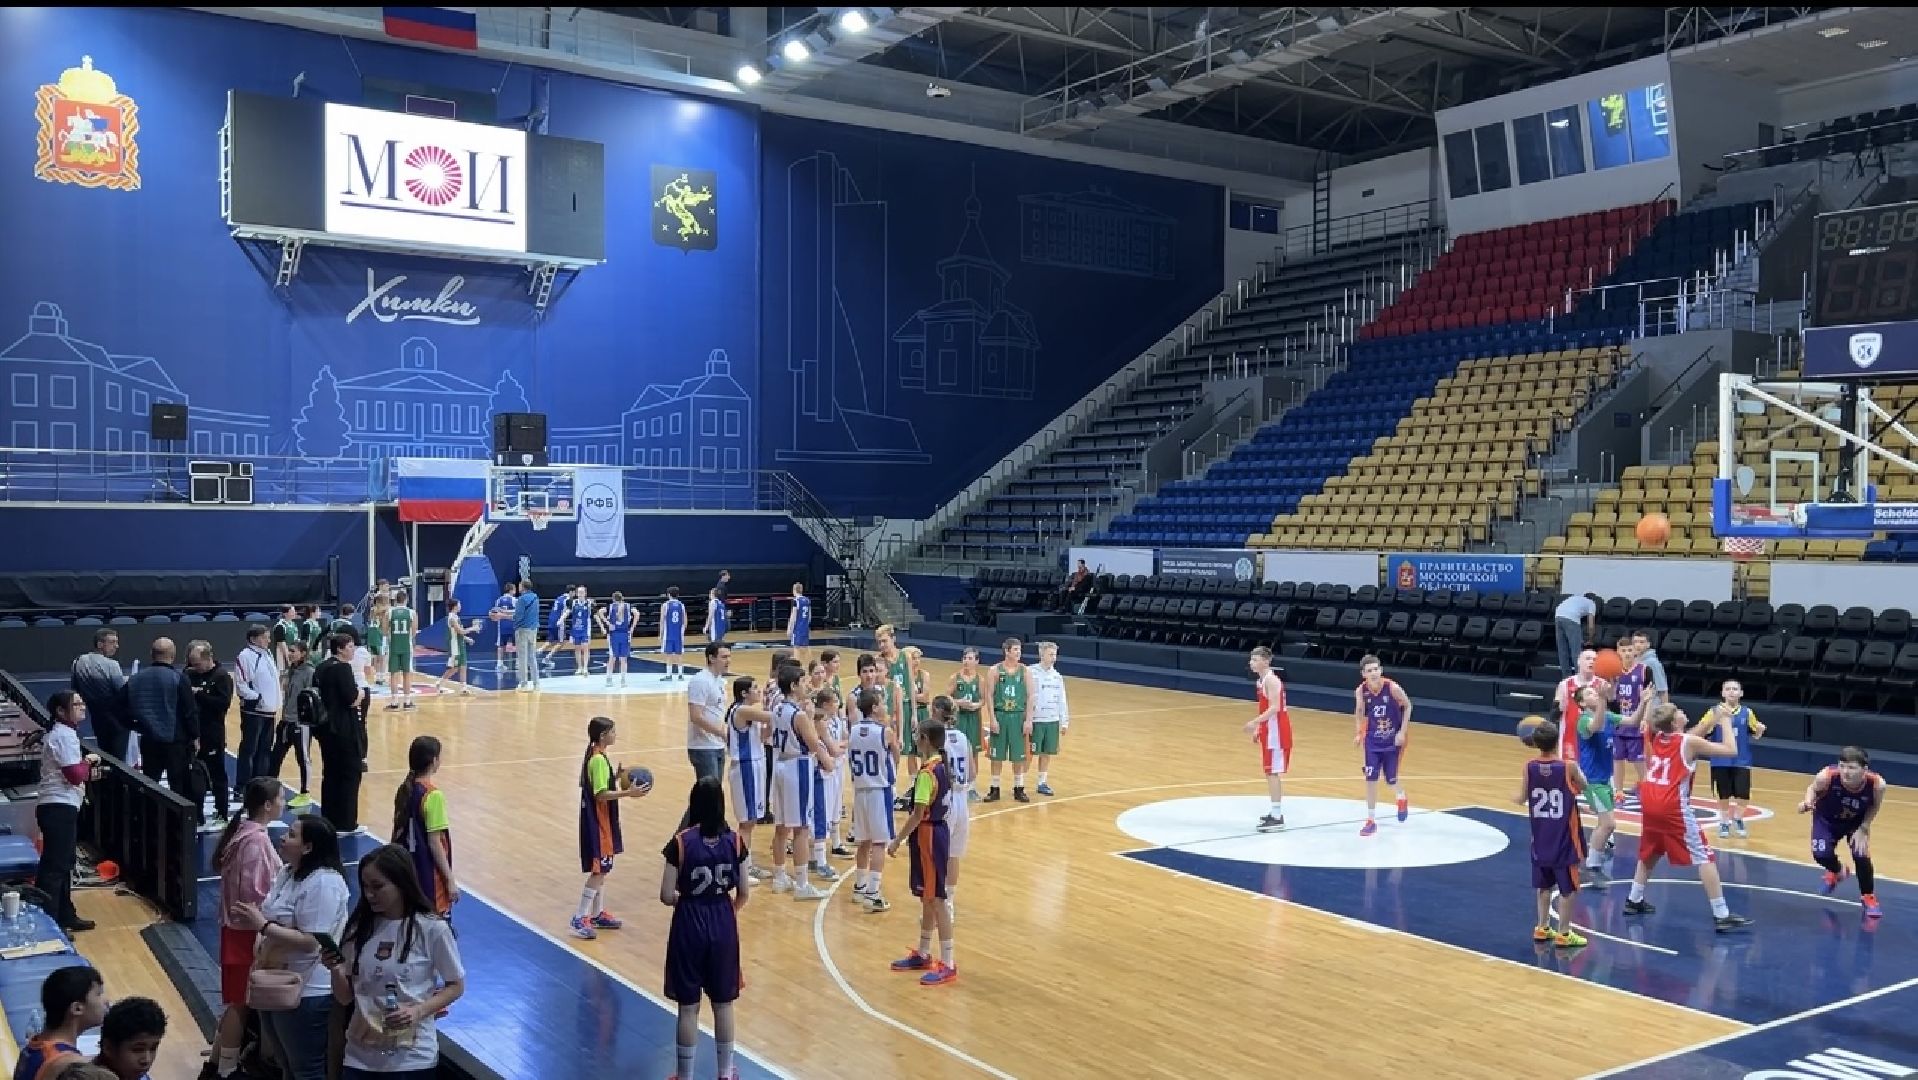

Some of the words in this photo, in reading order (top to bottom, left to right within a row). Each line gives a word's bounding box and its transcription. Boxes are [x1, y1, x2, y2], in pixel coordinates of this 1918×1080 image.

[346, 268, 480, 325] Химки
[586, 498, 613, 508] РФБ
[1419, 562, 1514, 573] ПРАВИТЕЛЬСТВО
[1419, 571, 1499, 583] МОСКОВСКОЙ
[671, 611, 679, 623] 8
[393, 620, 408, 634] 11
[1004, 684, 1016, 697] 41
[1619, 684, 1632, 695] 30
[1373, 705, 1387, 718] 27
[851, 749, 879, 777] 50
[1646, 755, 1671, 785] 21
[1531, 787, 1564, 819] 29
[1812, 839, 1826, 852] 28
[690, 863, 732, 895] 25
